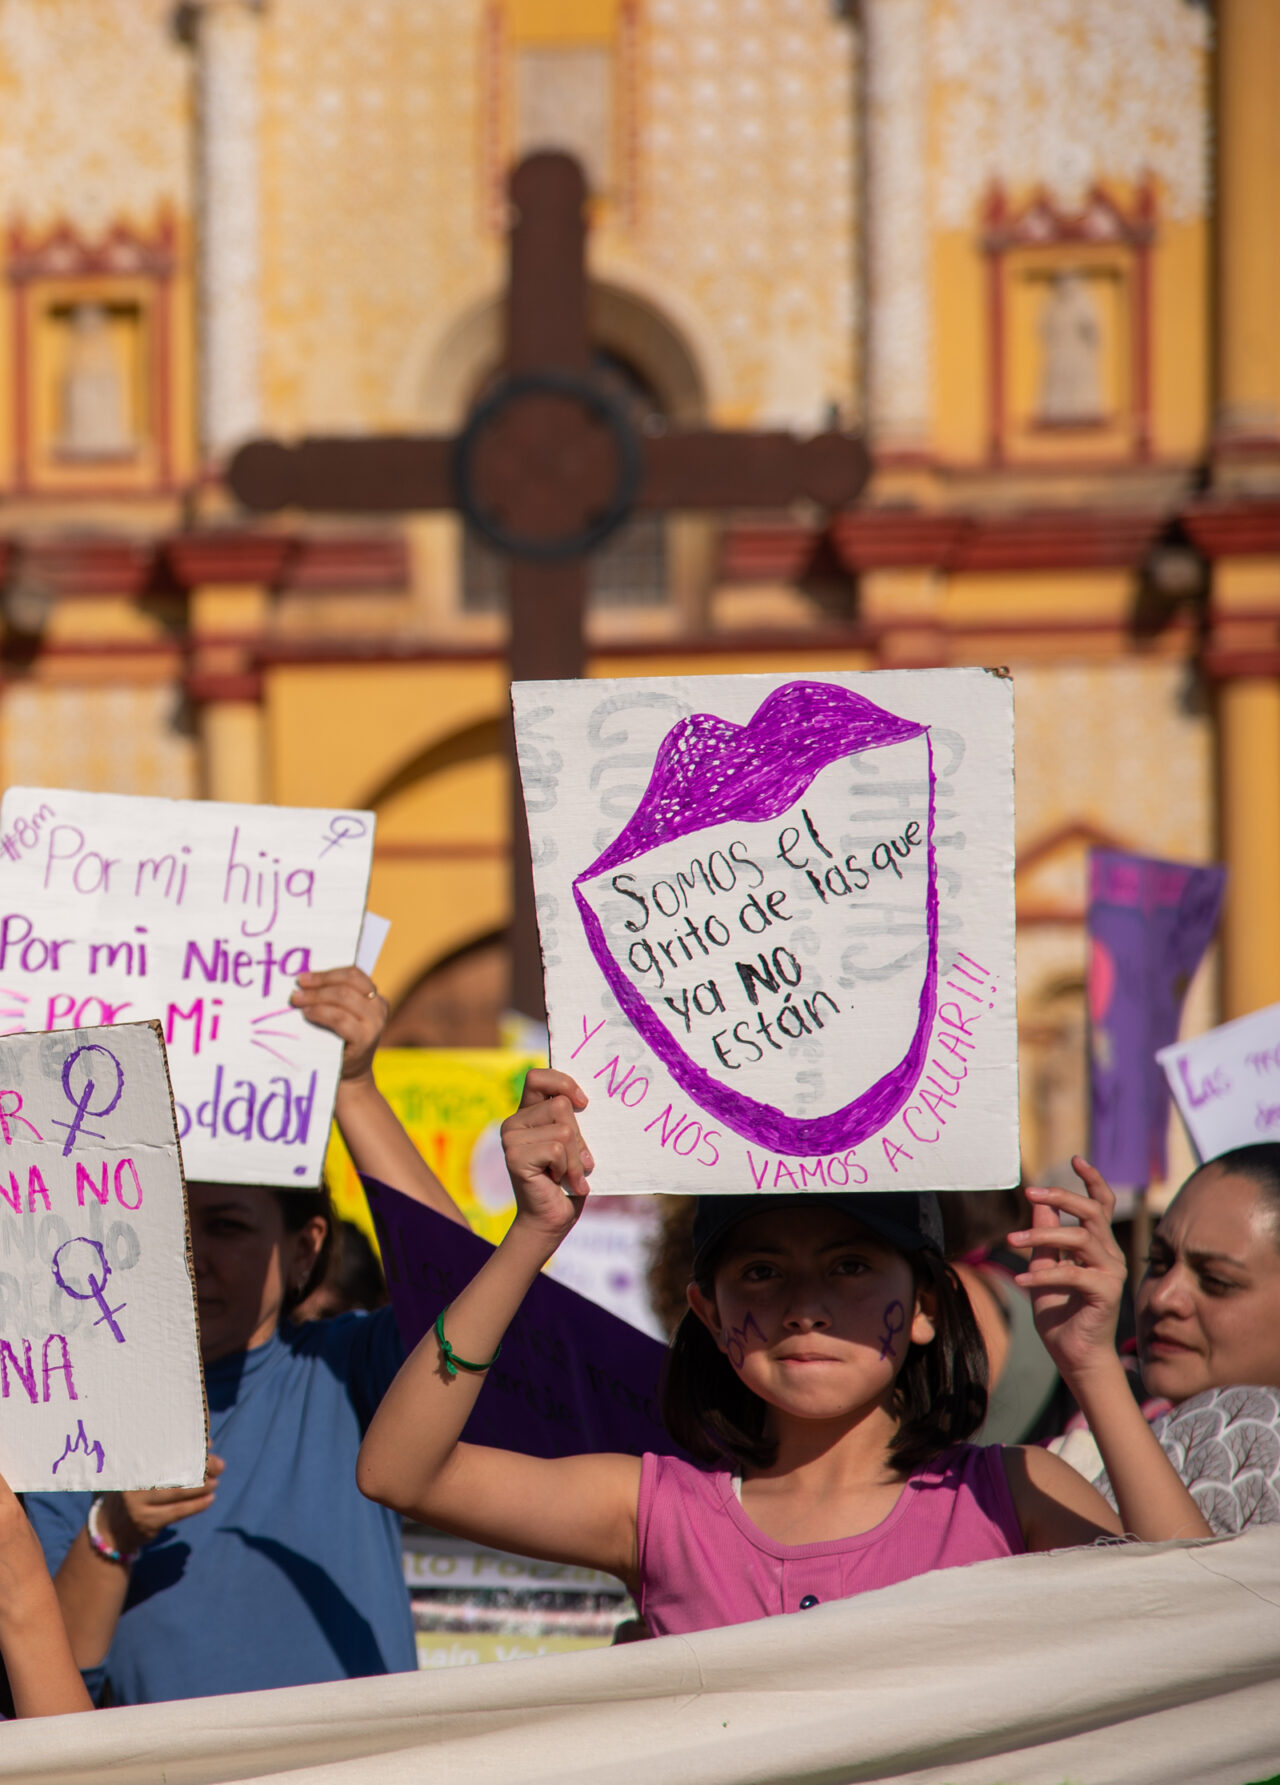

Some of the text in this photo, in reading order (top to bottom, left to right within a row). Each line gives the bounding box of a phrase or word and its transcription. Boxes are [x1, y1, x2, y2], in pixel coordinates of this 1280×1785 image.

[44, 825, 316, 938] Por mi hija
[777, 809, 833, 870] el
[628, 821, 922, 989] grito de las que
[89, 925, 149, 977] mi
[182, 938, 311, 998] Nieta
[664, 946, 802, 1033] ya NO
[570, 1014, 606, 1060] Y
[593, 1055, 649, 1108] NO
[644, 1103, 722, 1167] NOS
[746, 1149, 868, 1190] VAMOS
[882, 1137, 914, 1172] A
[76, 1158, 143, 1211] NO
